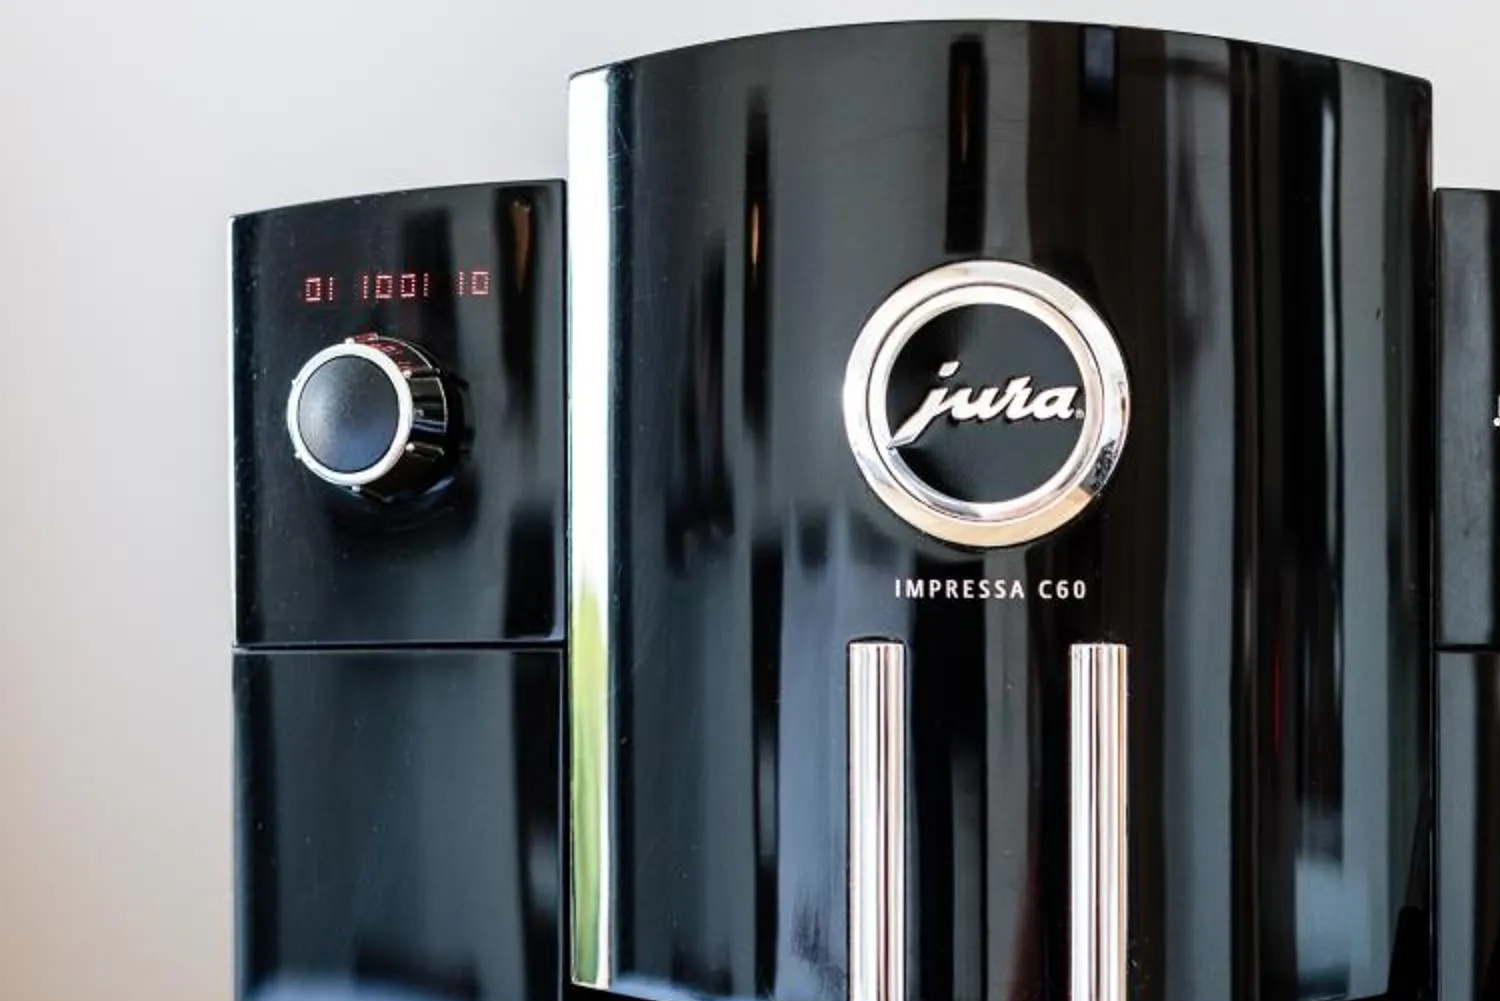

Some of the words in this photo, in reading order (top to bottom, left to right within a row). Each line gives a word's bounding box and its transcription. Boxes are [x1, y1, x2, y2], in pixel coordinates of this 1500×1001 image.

[887, 360, 1079, 450] jura
[894, 578, 1026, 600] IMPRESSA
[1038, 578, 1087, 600] C60
